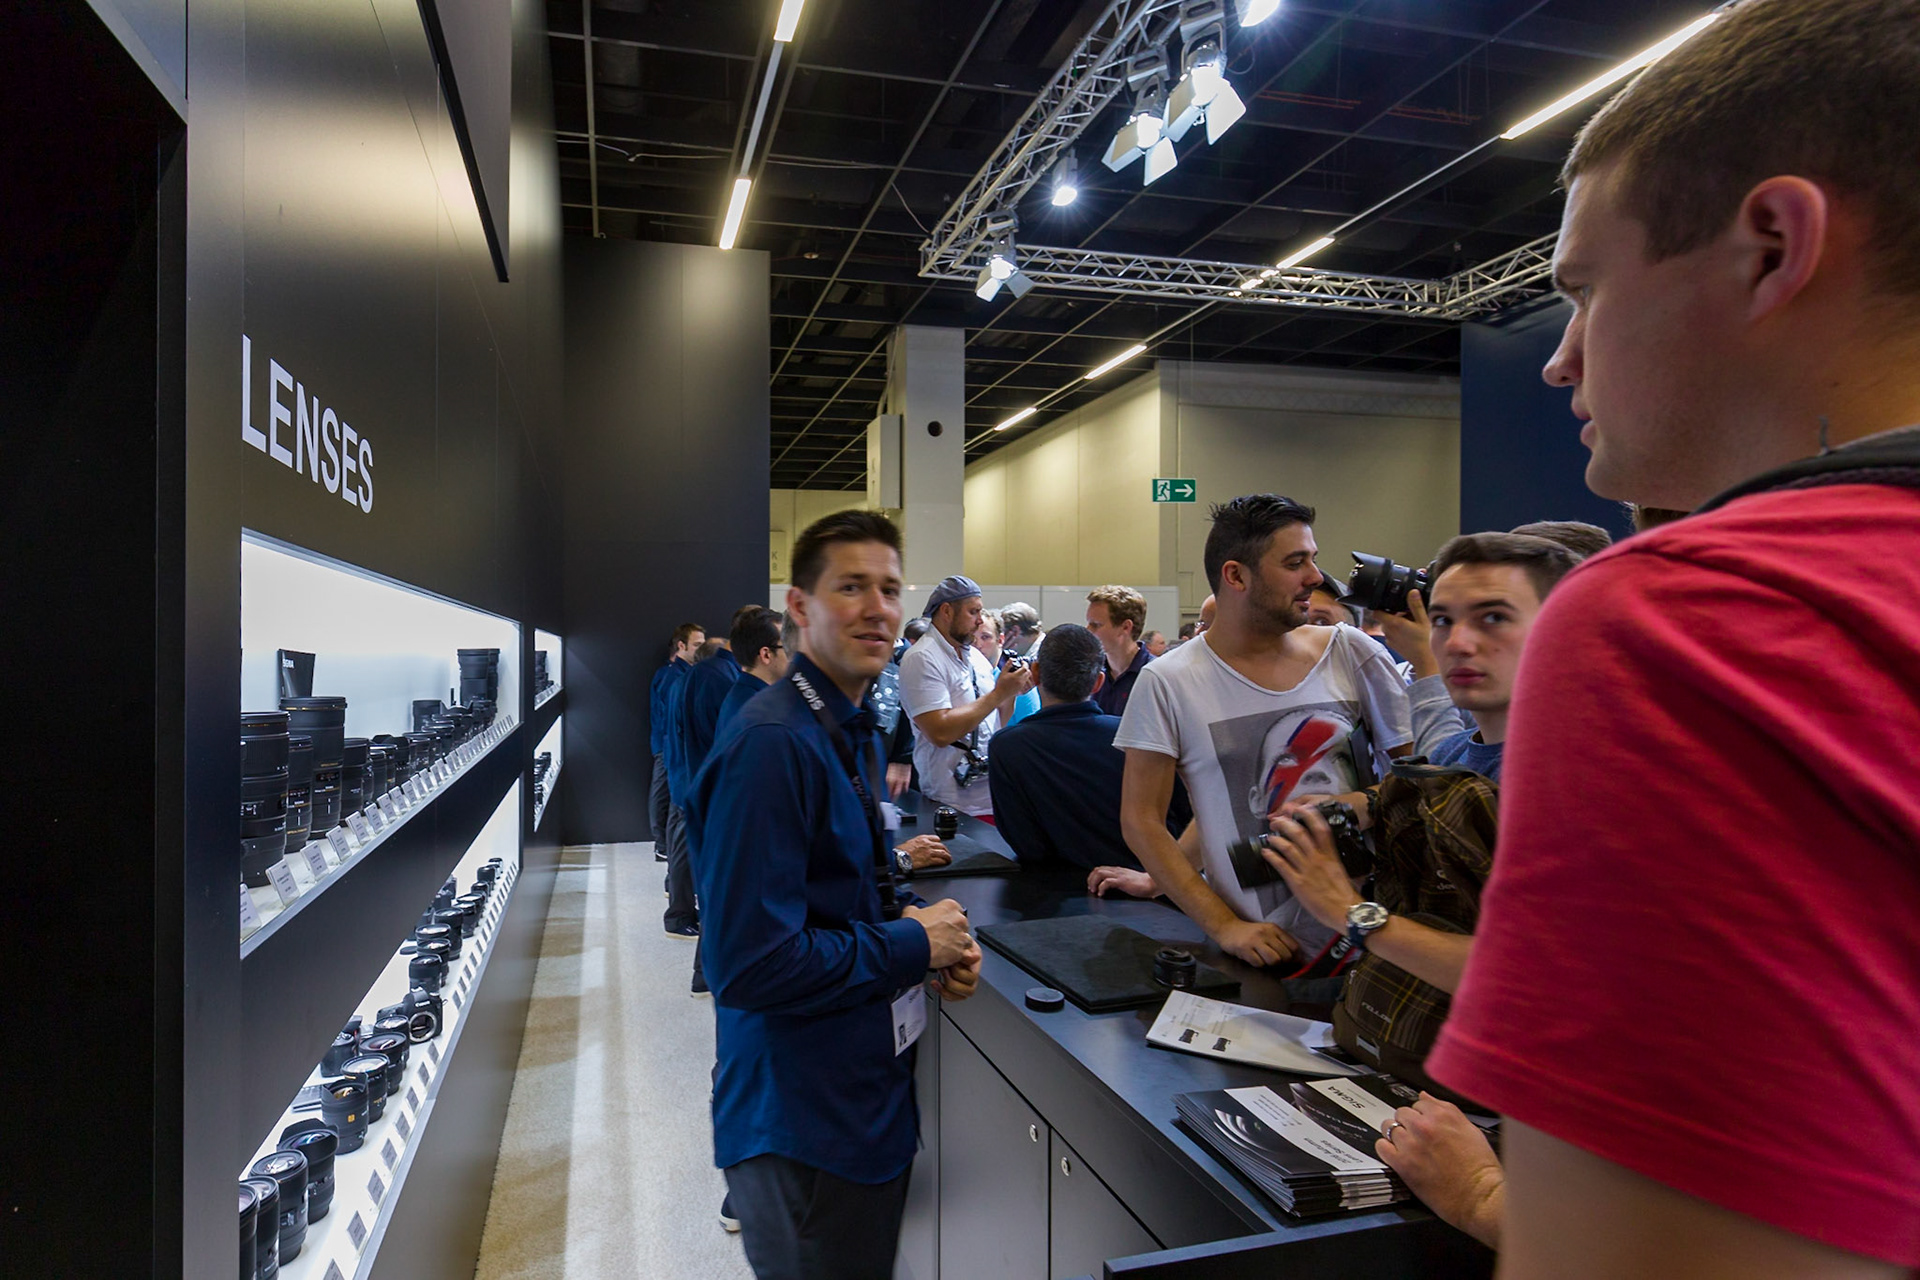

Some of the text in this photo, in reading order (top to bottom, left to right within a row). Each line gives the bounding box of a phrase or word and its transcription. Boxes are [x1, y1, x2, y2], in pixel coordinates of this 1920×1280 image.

[242, 333, 374, 514] LENSES
[791, 671, 825, 710] SIGMA
[1328, 1085, 1366, 1109] SIGMA
